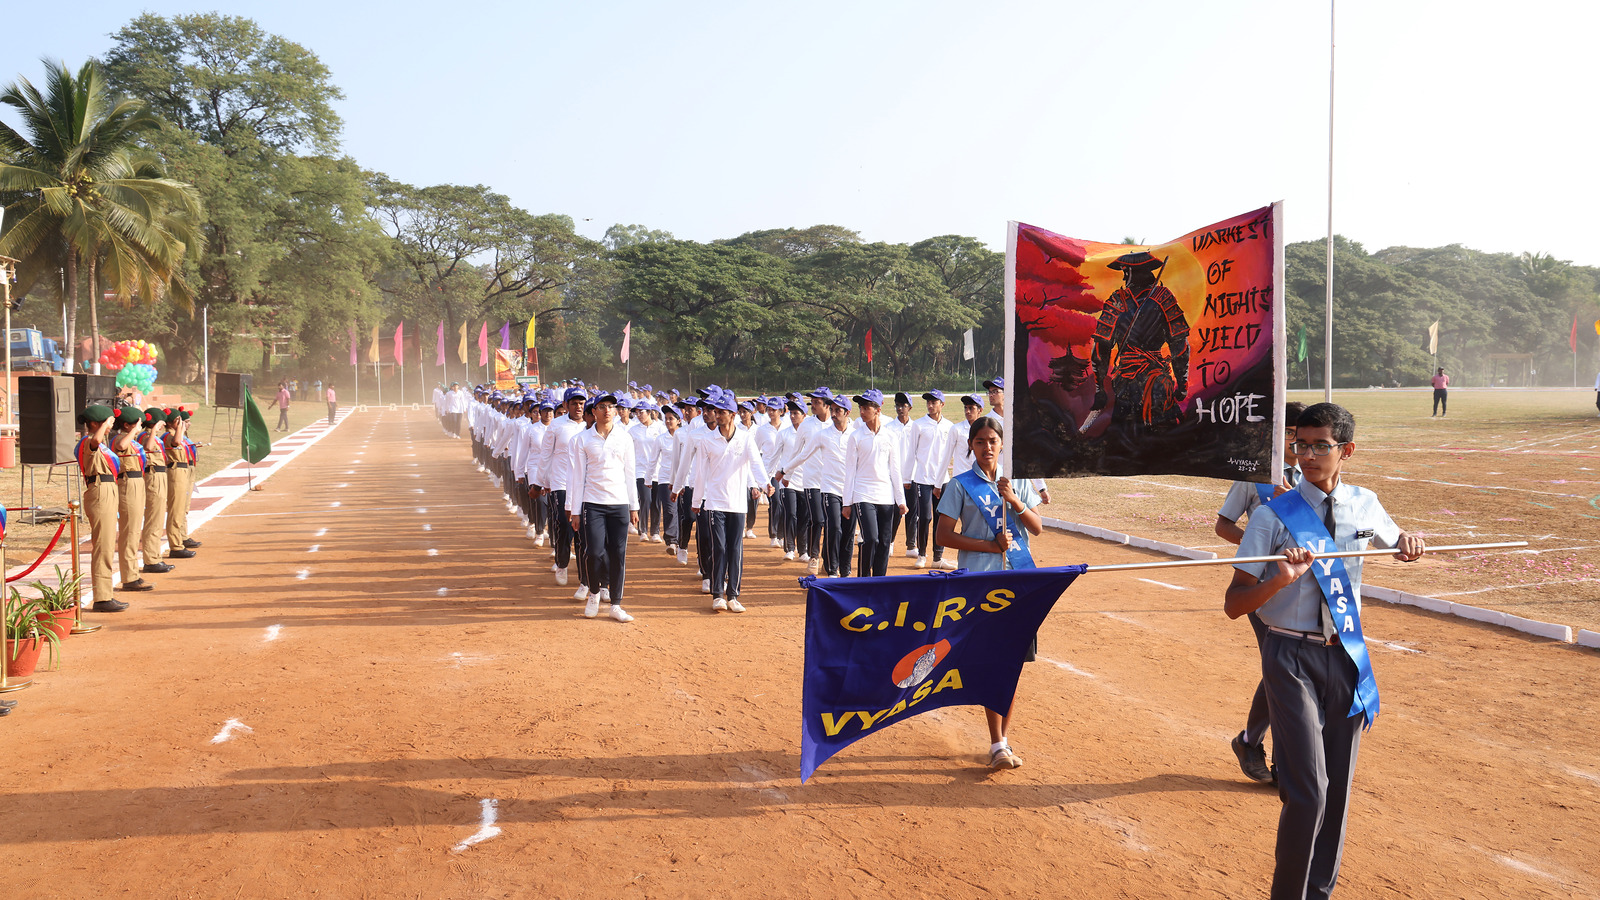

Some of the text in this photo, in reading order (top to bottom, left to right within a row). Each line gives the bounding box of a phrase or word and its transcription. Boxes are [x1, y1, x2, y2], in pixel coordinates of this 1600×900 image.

[1207, 259, 1235, 285] OF
[1203, 286, 1273, 319] NIGHTS
[1197, 323, 1261, 353] YIELD
[1196, 358, 1231, 388] TO
[1195, 391, 1266, 425] HOPE
[1307, 539, 1355, 633] VYASA
[820, 668, 964, 737] VYASA
